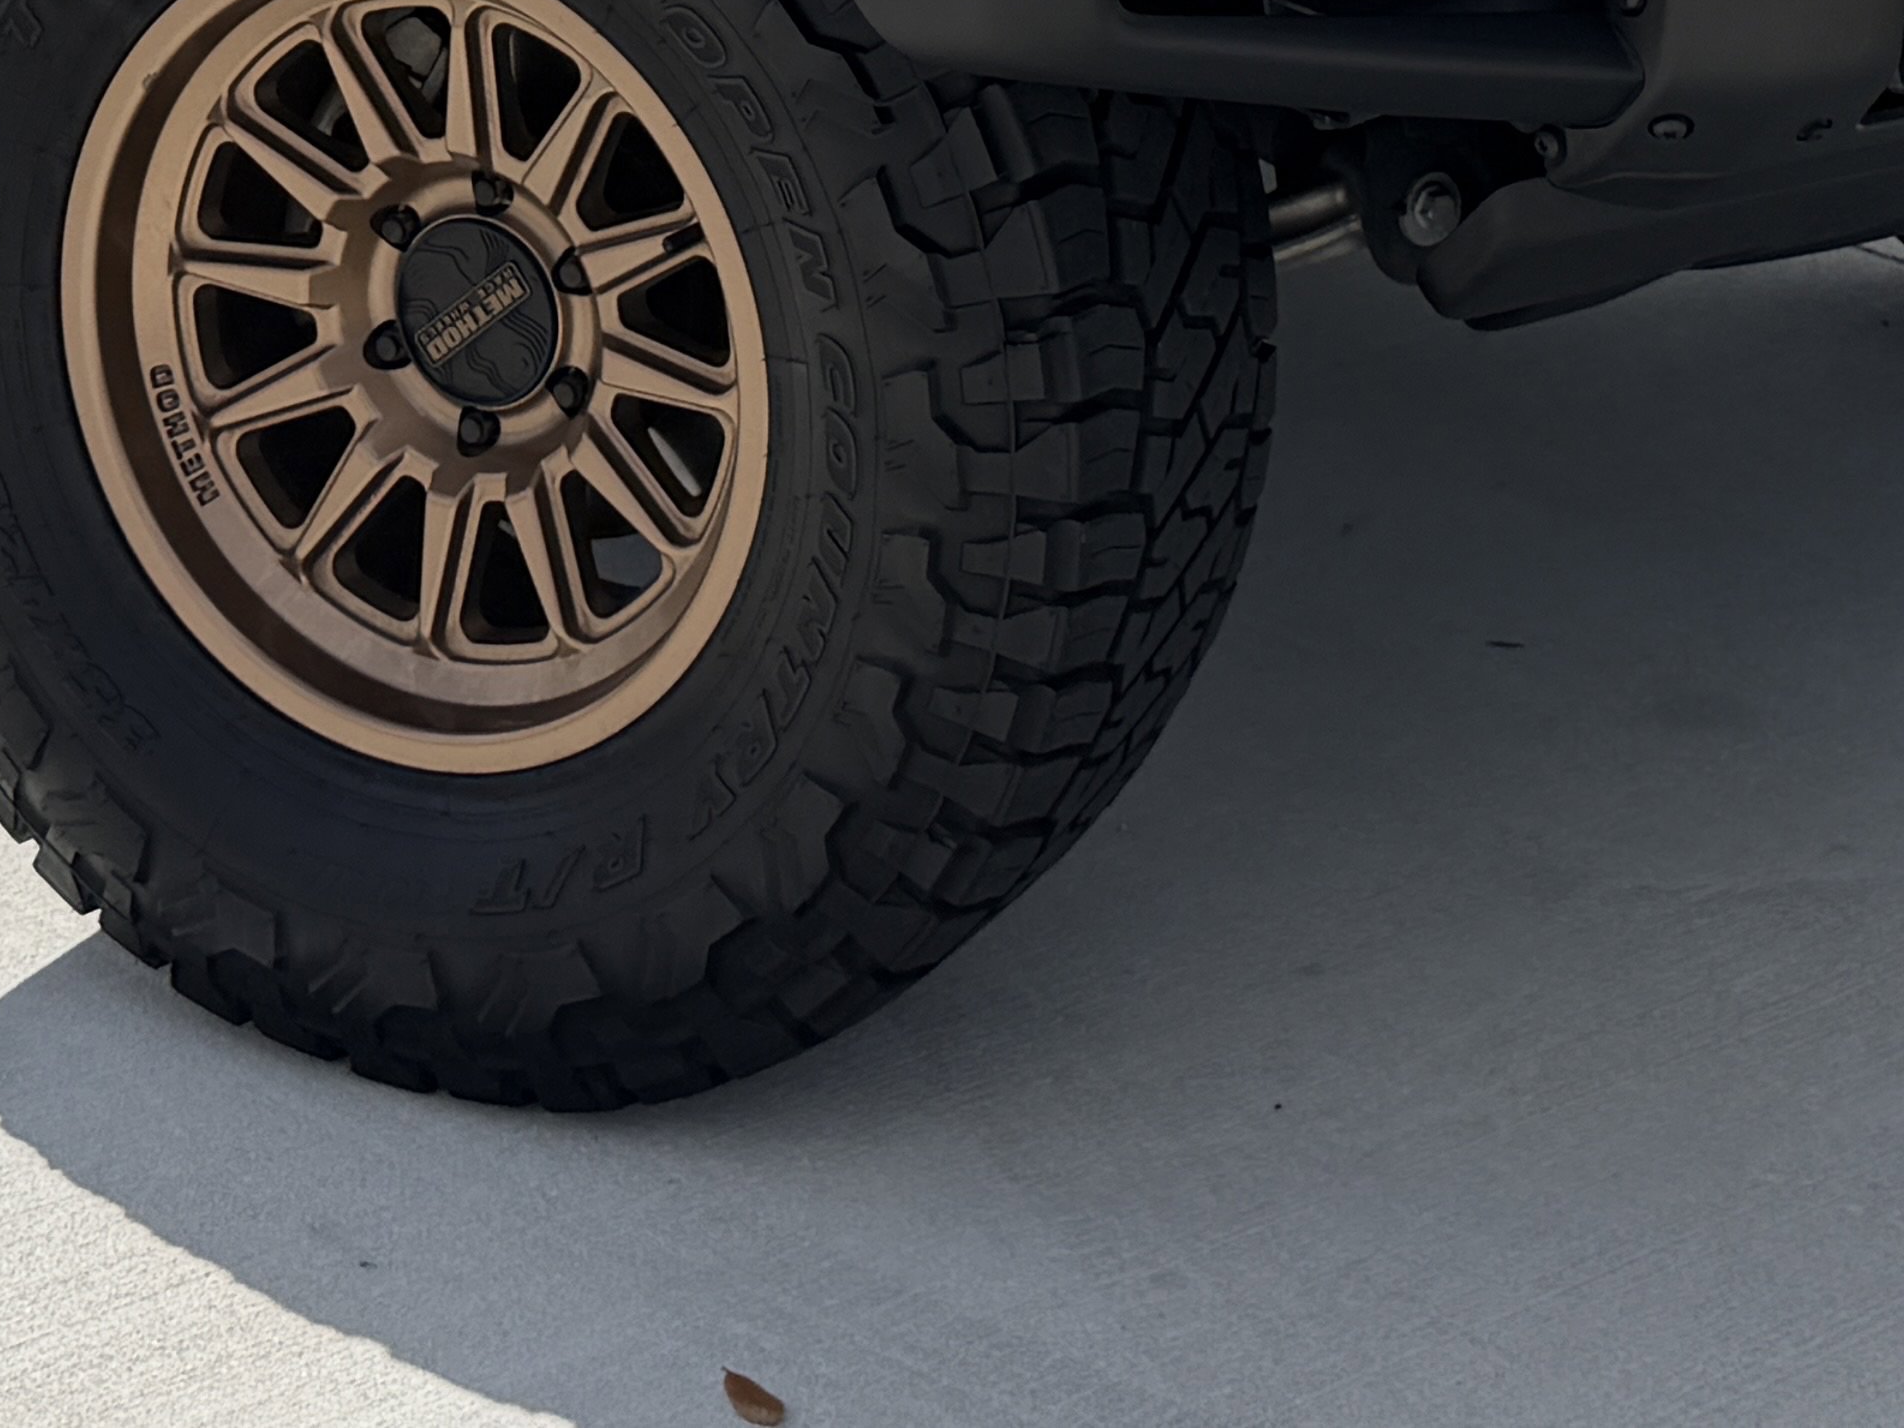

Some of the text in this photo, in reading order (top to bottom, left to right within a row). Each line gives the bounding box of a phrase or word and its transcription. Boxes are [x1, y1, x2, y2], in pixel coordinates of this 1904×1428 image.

[660, 0, 836, 312] OPEN
[426, 277, 525, 361] METHOD
[149, 363, 222, 508] METHOD
[686, 333, 859, 838] COUNTRY
